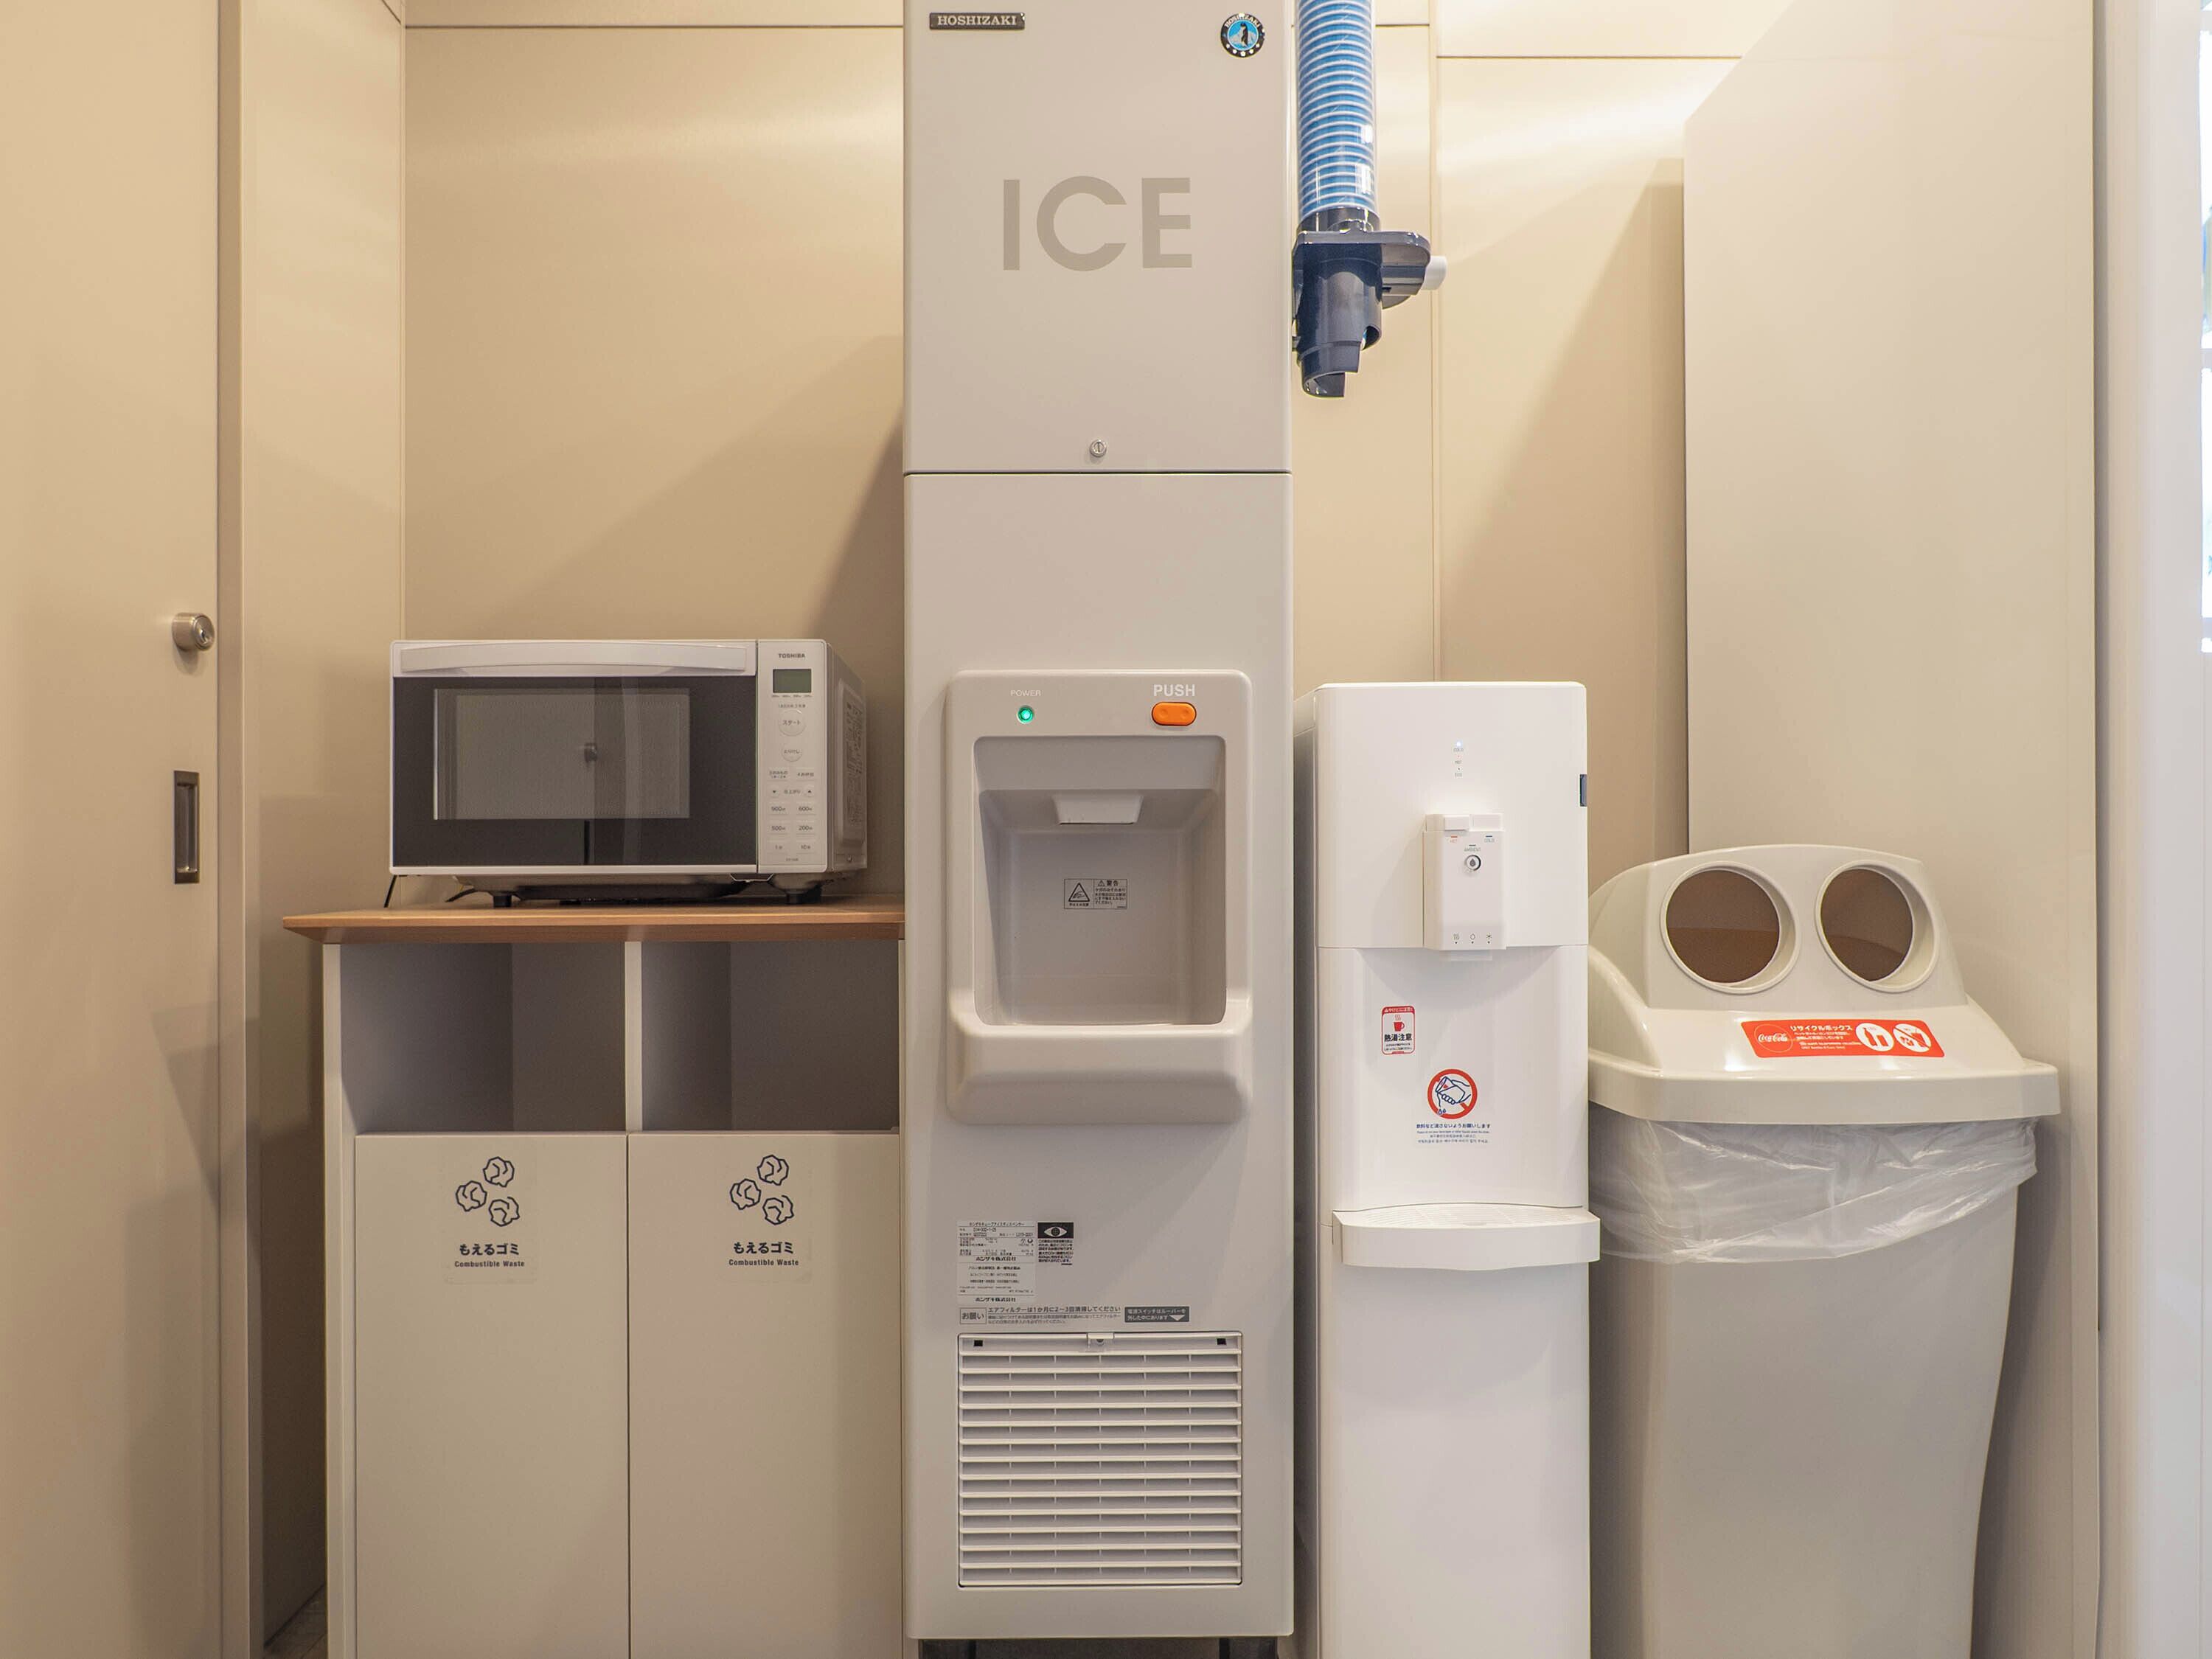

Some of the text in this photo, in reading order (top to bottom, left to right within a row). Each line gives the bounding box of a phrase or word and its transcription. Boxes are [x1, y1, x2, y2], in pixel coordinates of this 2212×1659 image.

[938, 15, 1016, 25] HOSHIZAKI
[1003, 176, 1192, 271] ICE
[1154, 684, 1194, 696] PUSH
[459, 1243, 519, 1256] もえるゴミ
[734, 1242, 793, 1253] もえるゴミ
